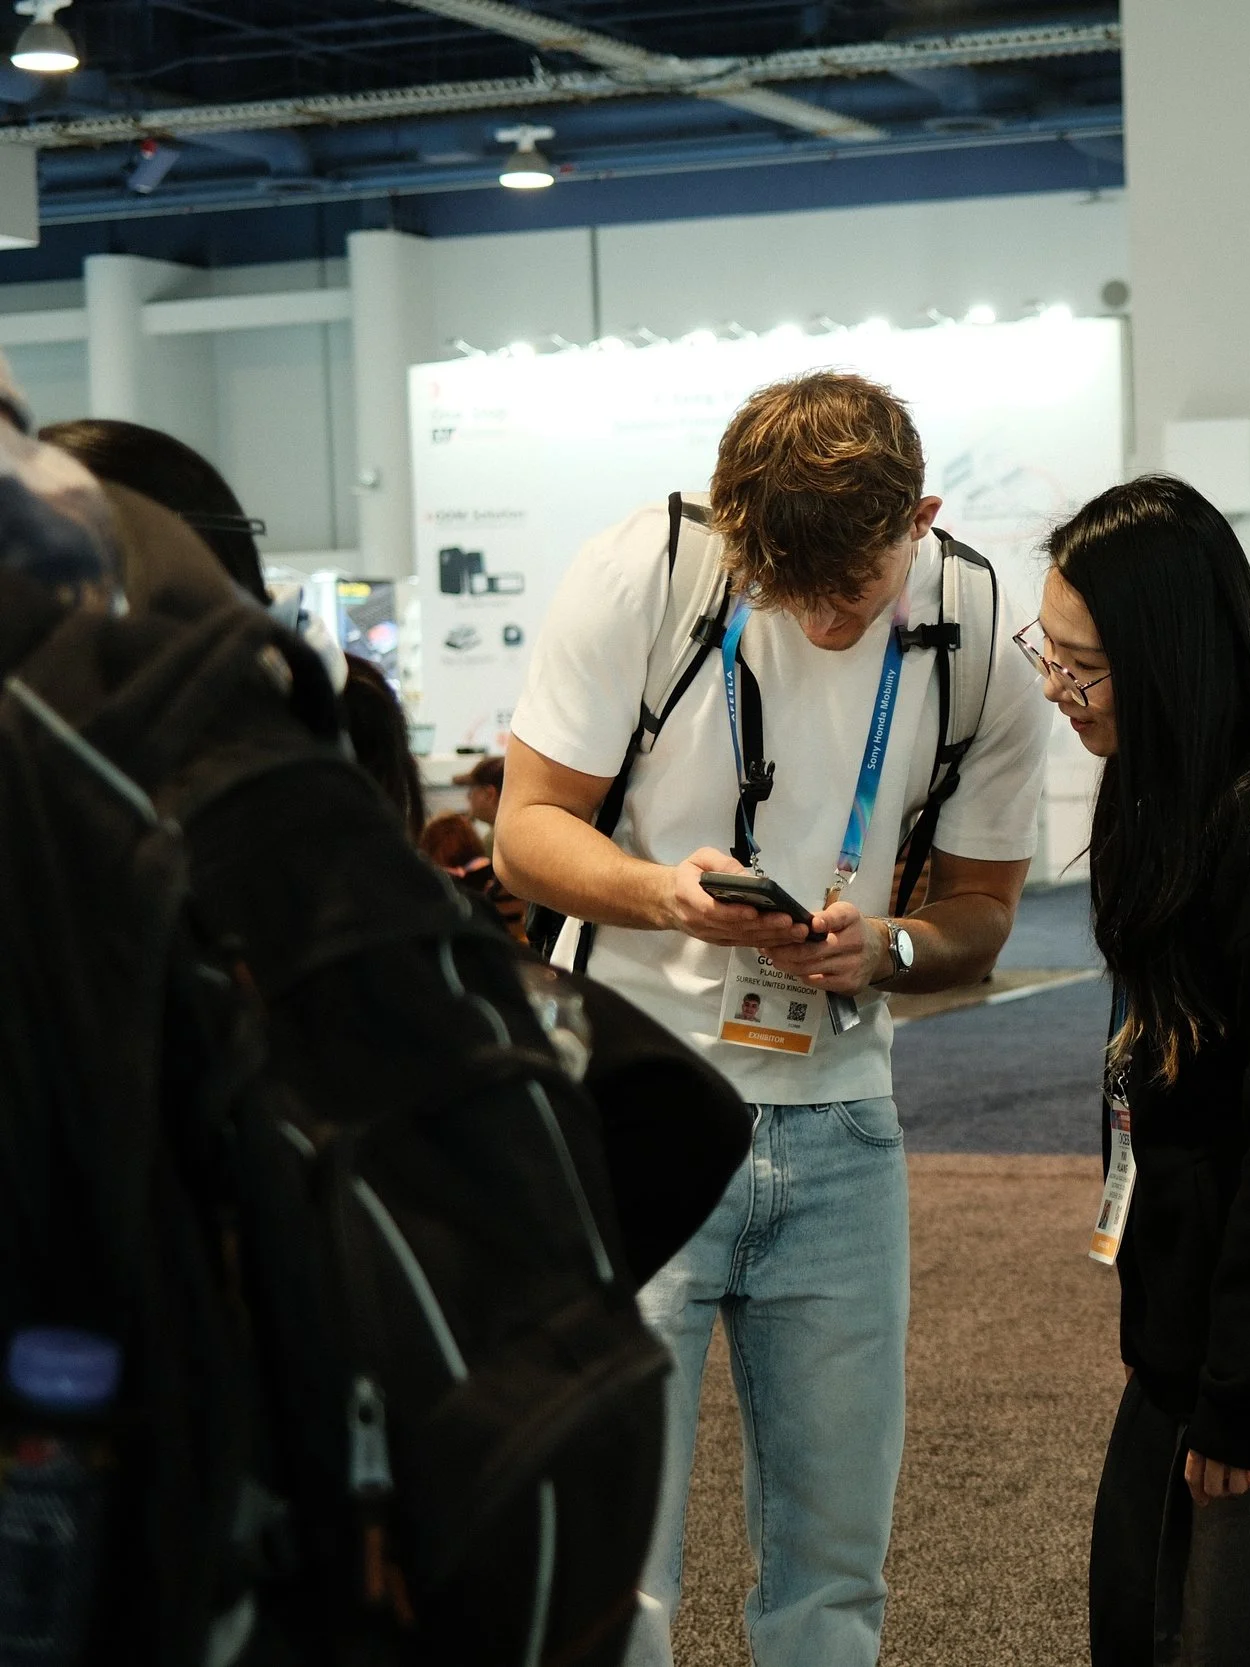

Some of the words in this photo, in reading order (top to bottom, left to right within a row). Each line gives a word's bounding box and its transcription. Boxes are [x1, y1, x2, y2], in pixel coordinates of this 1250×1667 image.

[727, 670, 735, 722] AFEELA
[880, 669, 896, 710] Mobility
[873, 711, 887, 744] Honda
[868, 745, 881, 770] Sony
[760, 968, 783, 979] PLAUD
[762, 979, 786, 990] UNITED
[786, 985, 818, 996] KINGDOM
[748, 1031, 785, 1044] EXHIBITOR
